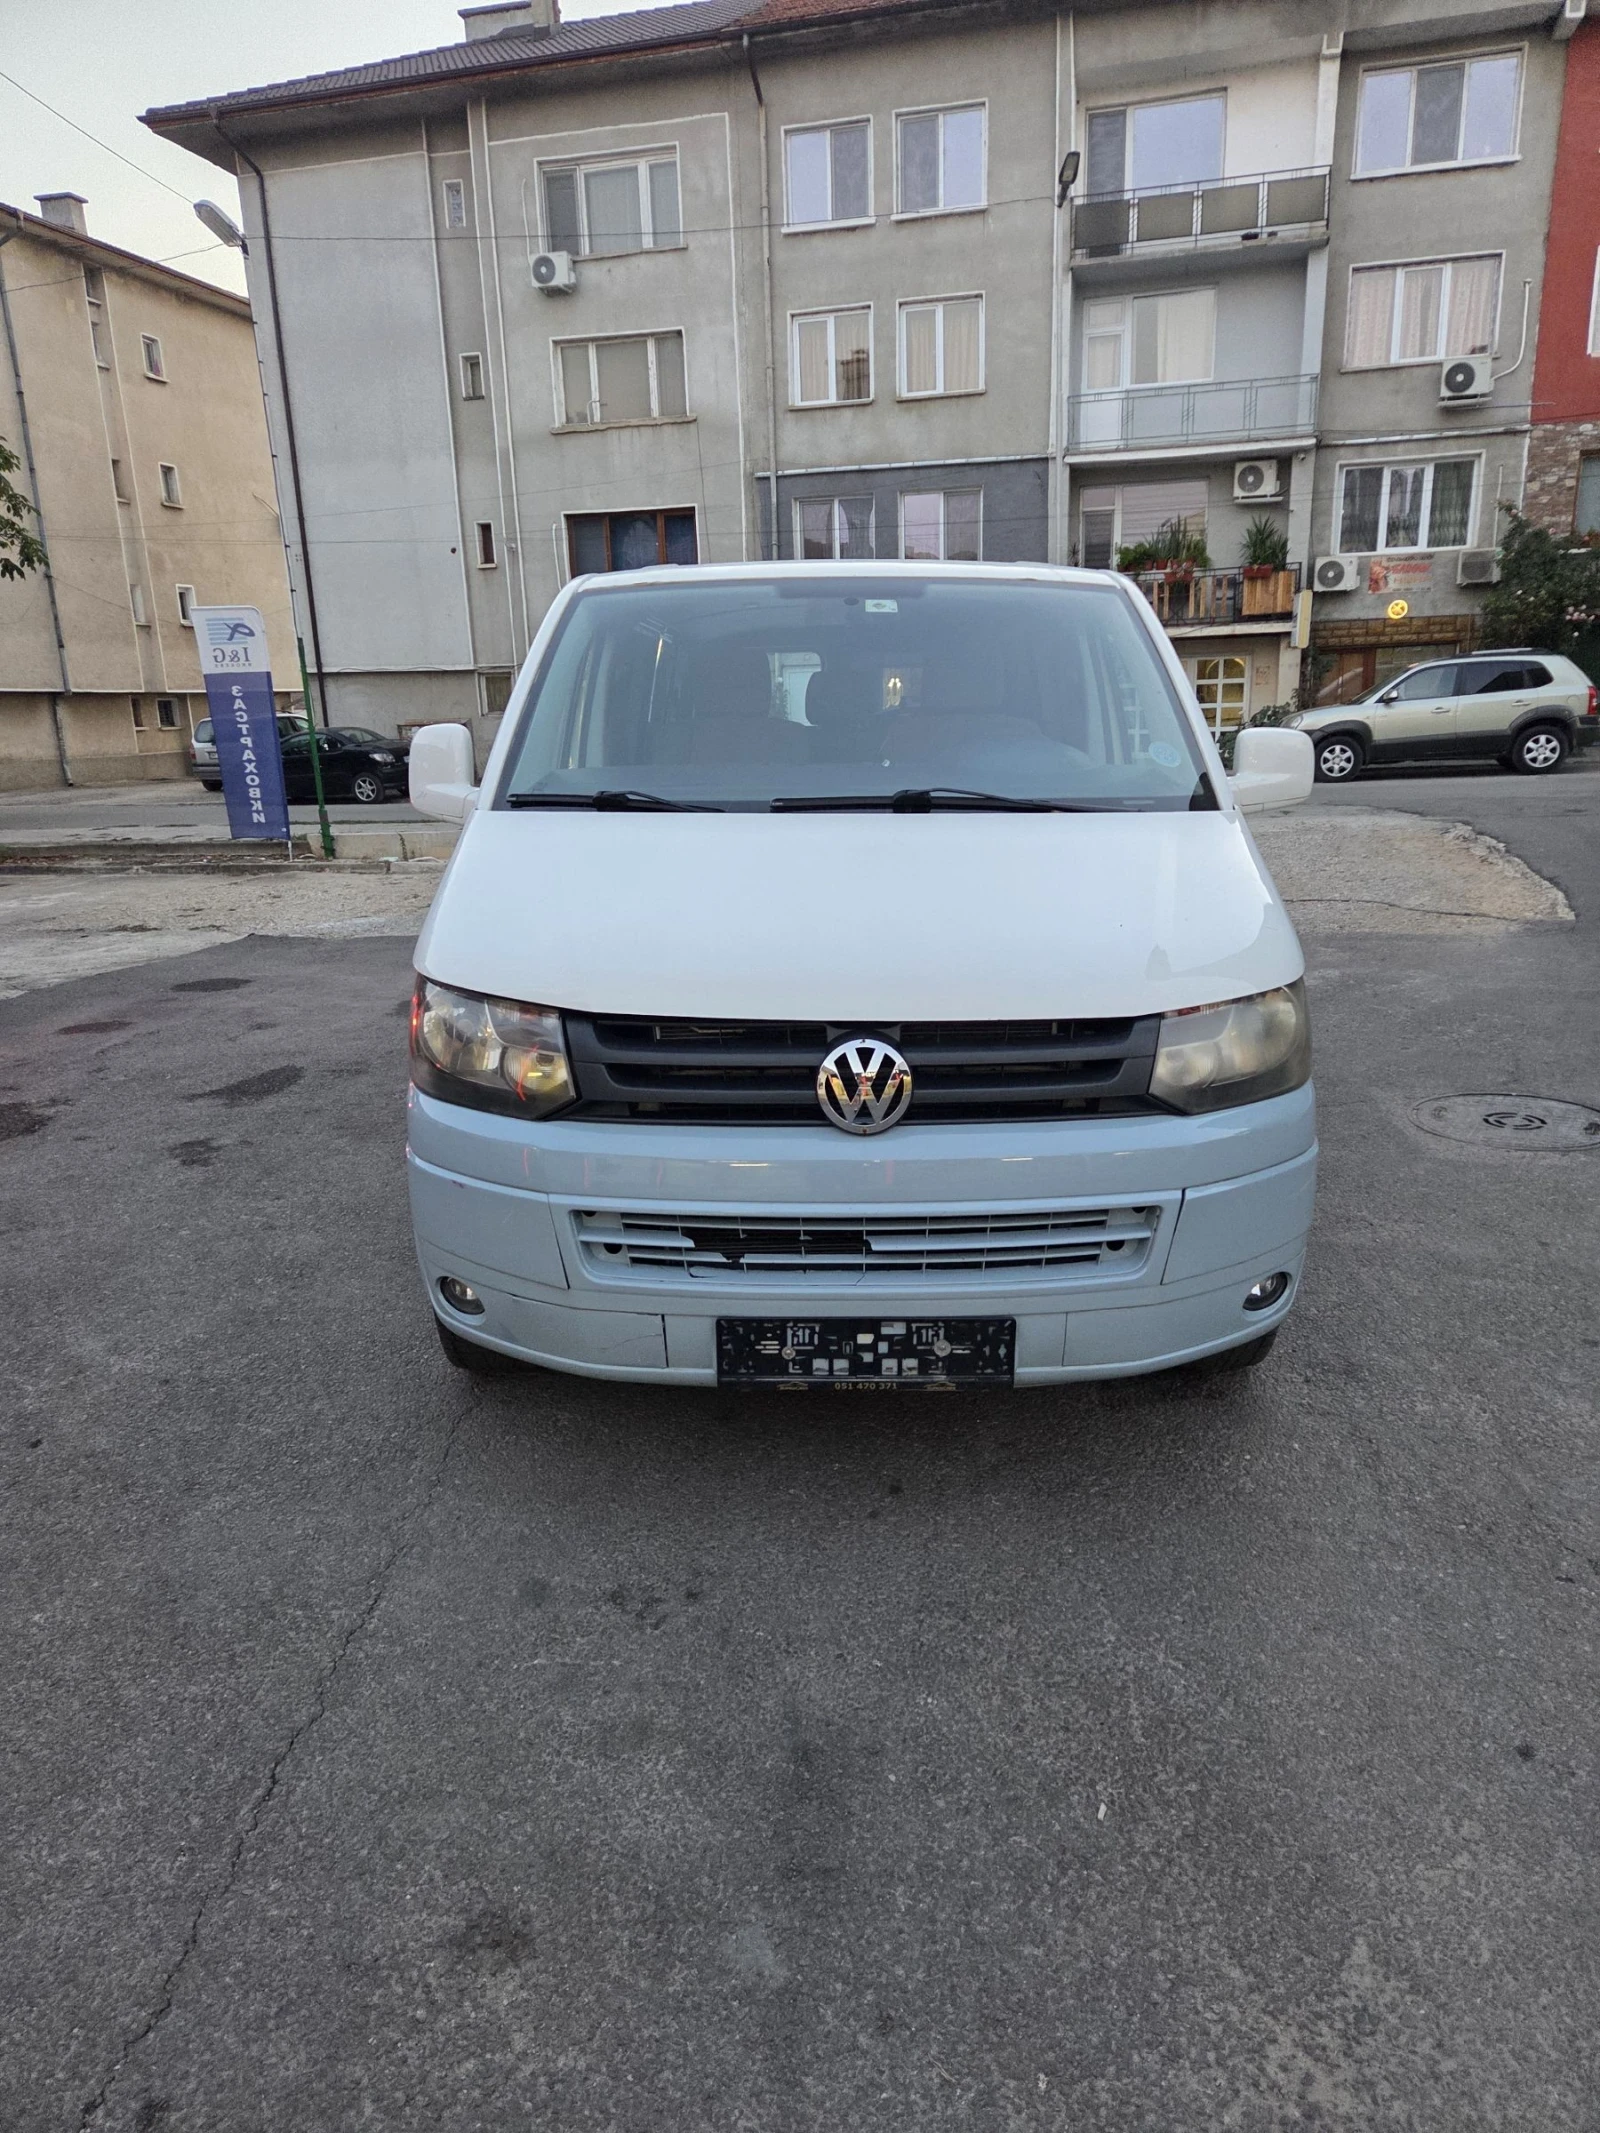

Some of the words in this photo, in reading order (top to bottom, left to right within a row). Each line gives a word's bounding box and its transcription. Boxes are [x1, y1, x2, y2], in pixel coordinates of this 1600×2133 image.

[834, 1382, 854, 1391] 051
[856, 1382, 876, 1391] 470
[879, 1382, 897, 1391] 371
